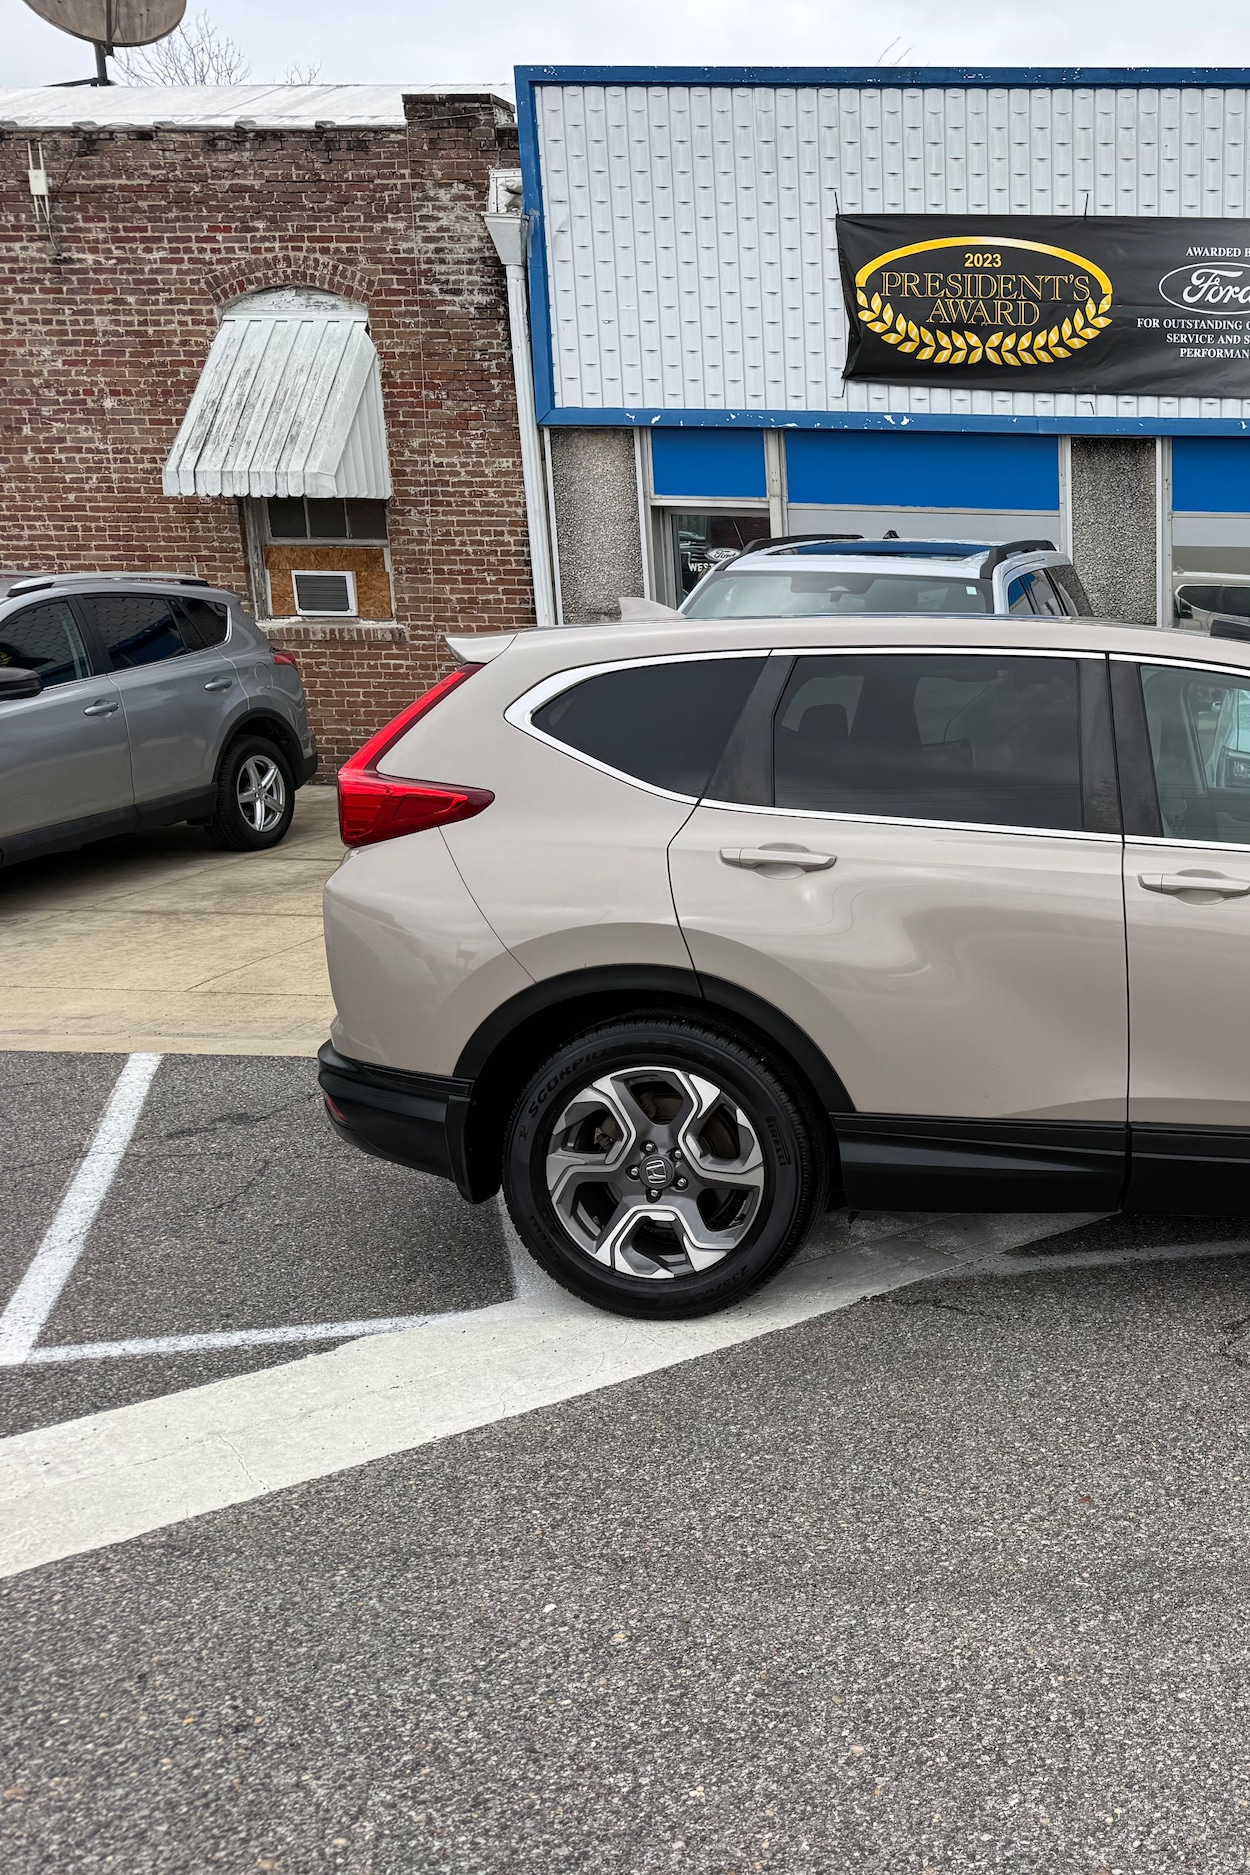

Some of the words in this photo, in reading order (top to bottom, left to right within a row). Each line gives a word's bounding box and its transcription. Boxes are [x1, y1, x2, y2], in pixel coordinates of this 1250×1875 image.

[1186, 247, 1241, 257] AWARDED
[964, 253, 1002, 267] 2023
[880, 271, 1091, 302] PRESIDENT'S
[926, 298, 1041, 326] AWARD
[1137, 318, 1160, 329] FOR
[1163, 319, 1243, 331] OUTSTANDING
[1166, 333, 1215, 344] SERVICE
[1217, 334, 1241, 345] AND
[714, 550, 737, 559] Ford
